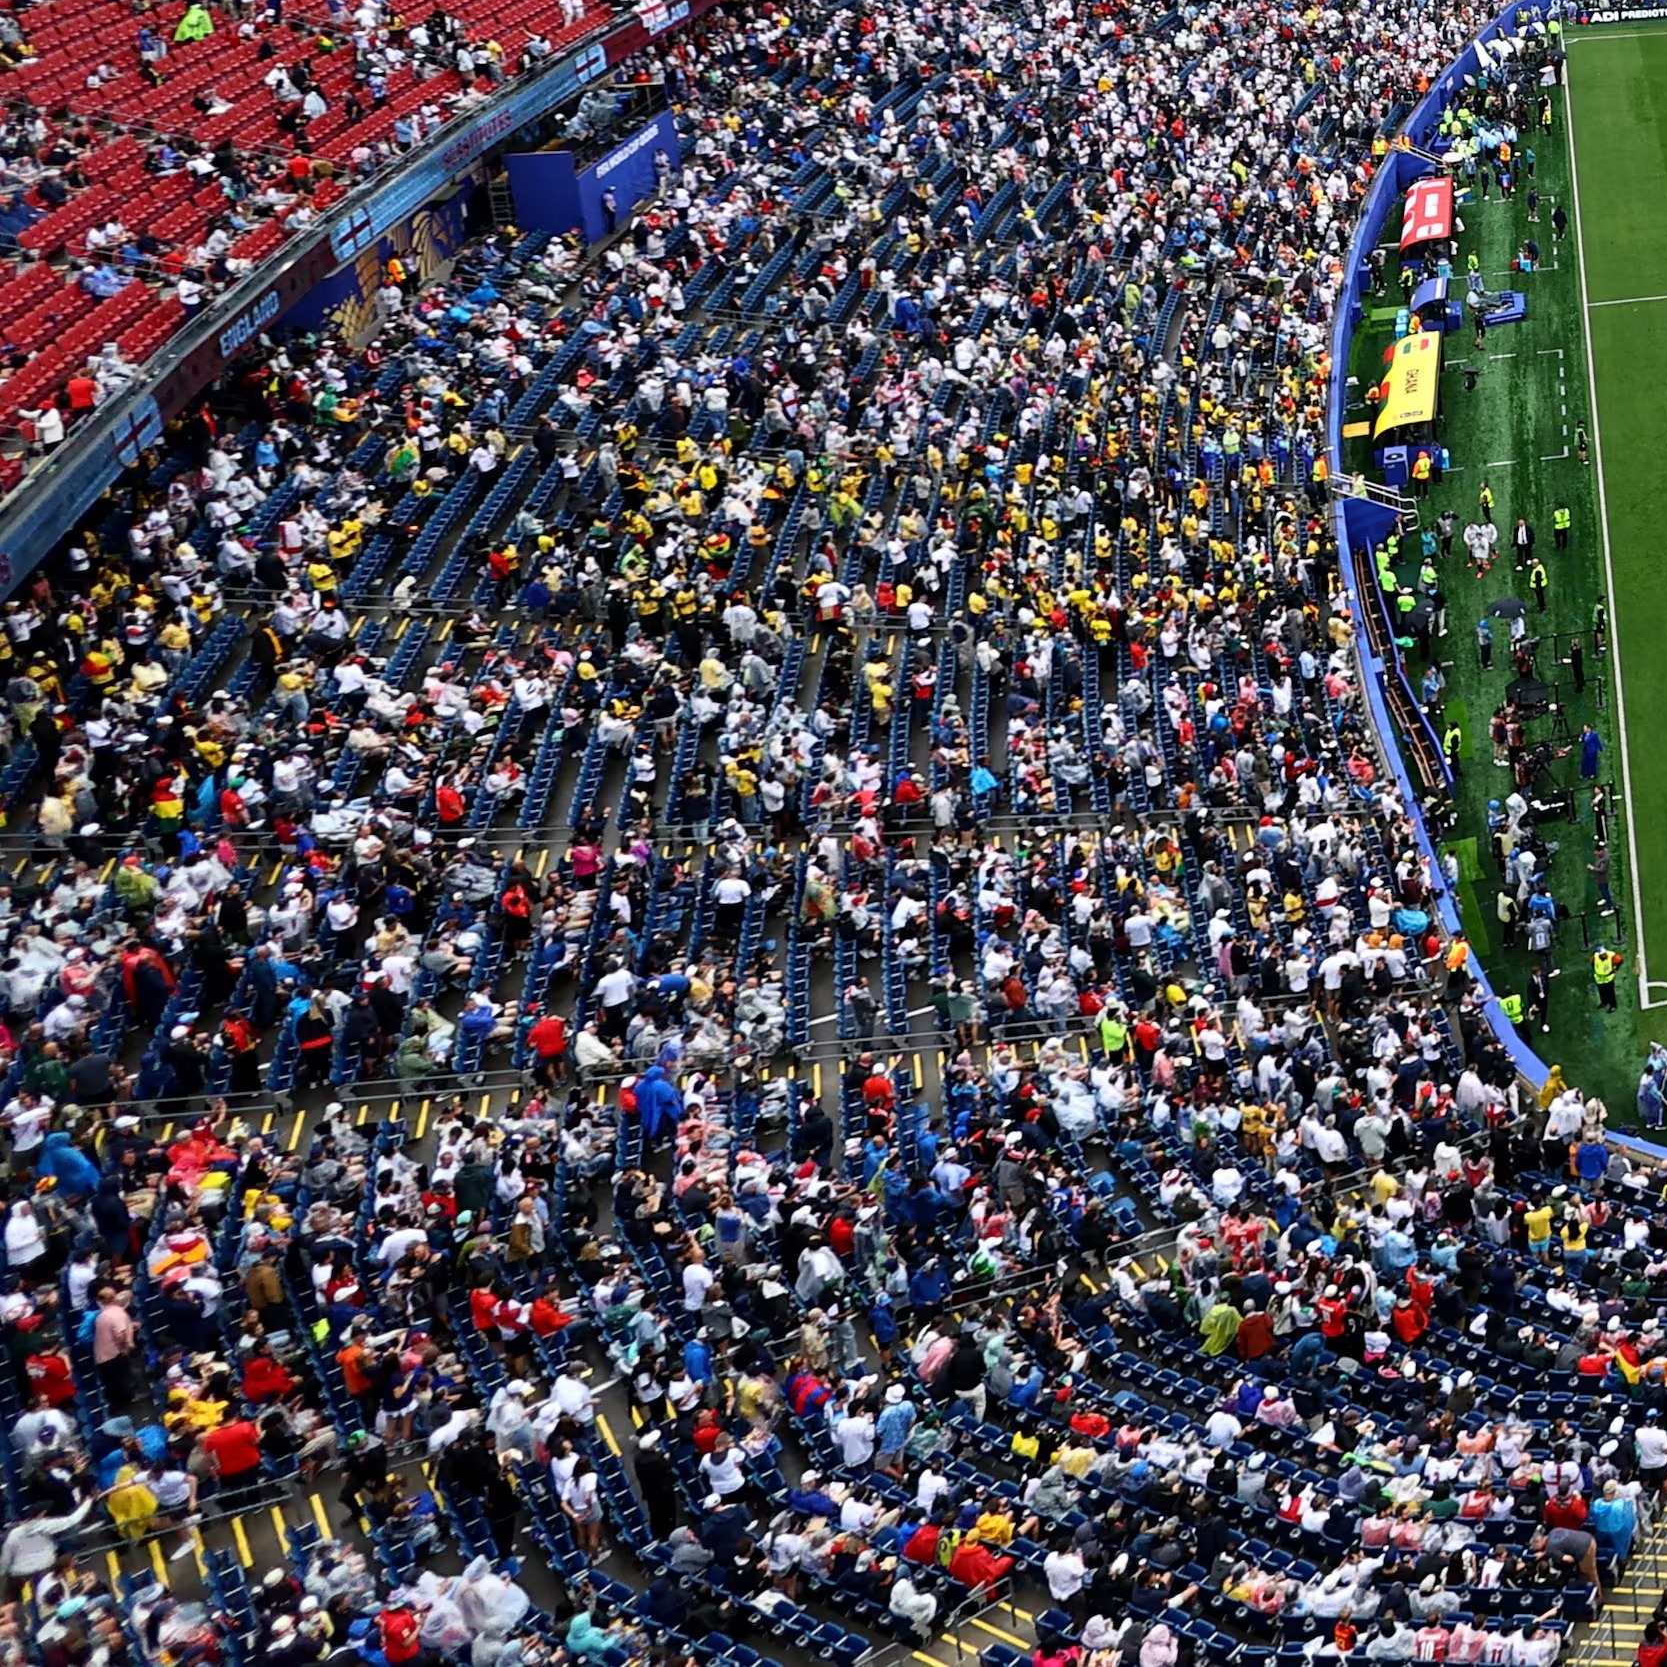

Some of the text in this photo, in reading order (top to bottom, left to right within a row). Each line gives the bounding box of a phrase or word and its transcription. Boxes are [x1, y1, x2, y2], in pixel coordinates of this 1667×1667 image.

[1590, 11, 1620, 23] ADI
[219, 288, 280, 359] ENGLAND
[1405, 368, 1419, 395] GHANA
